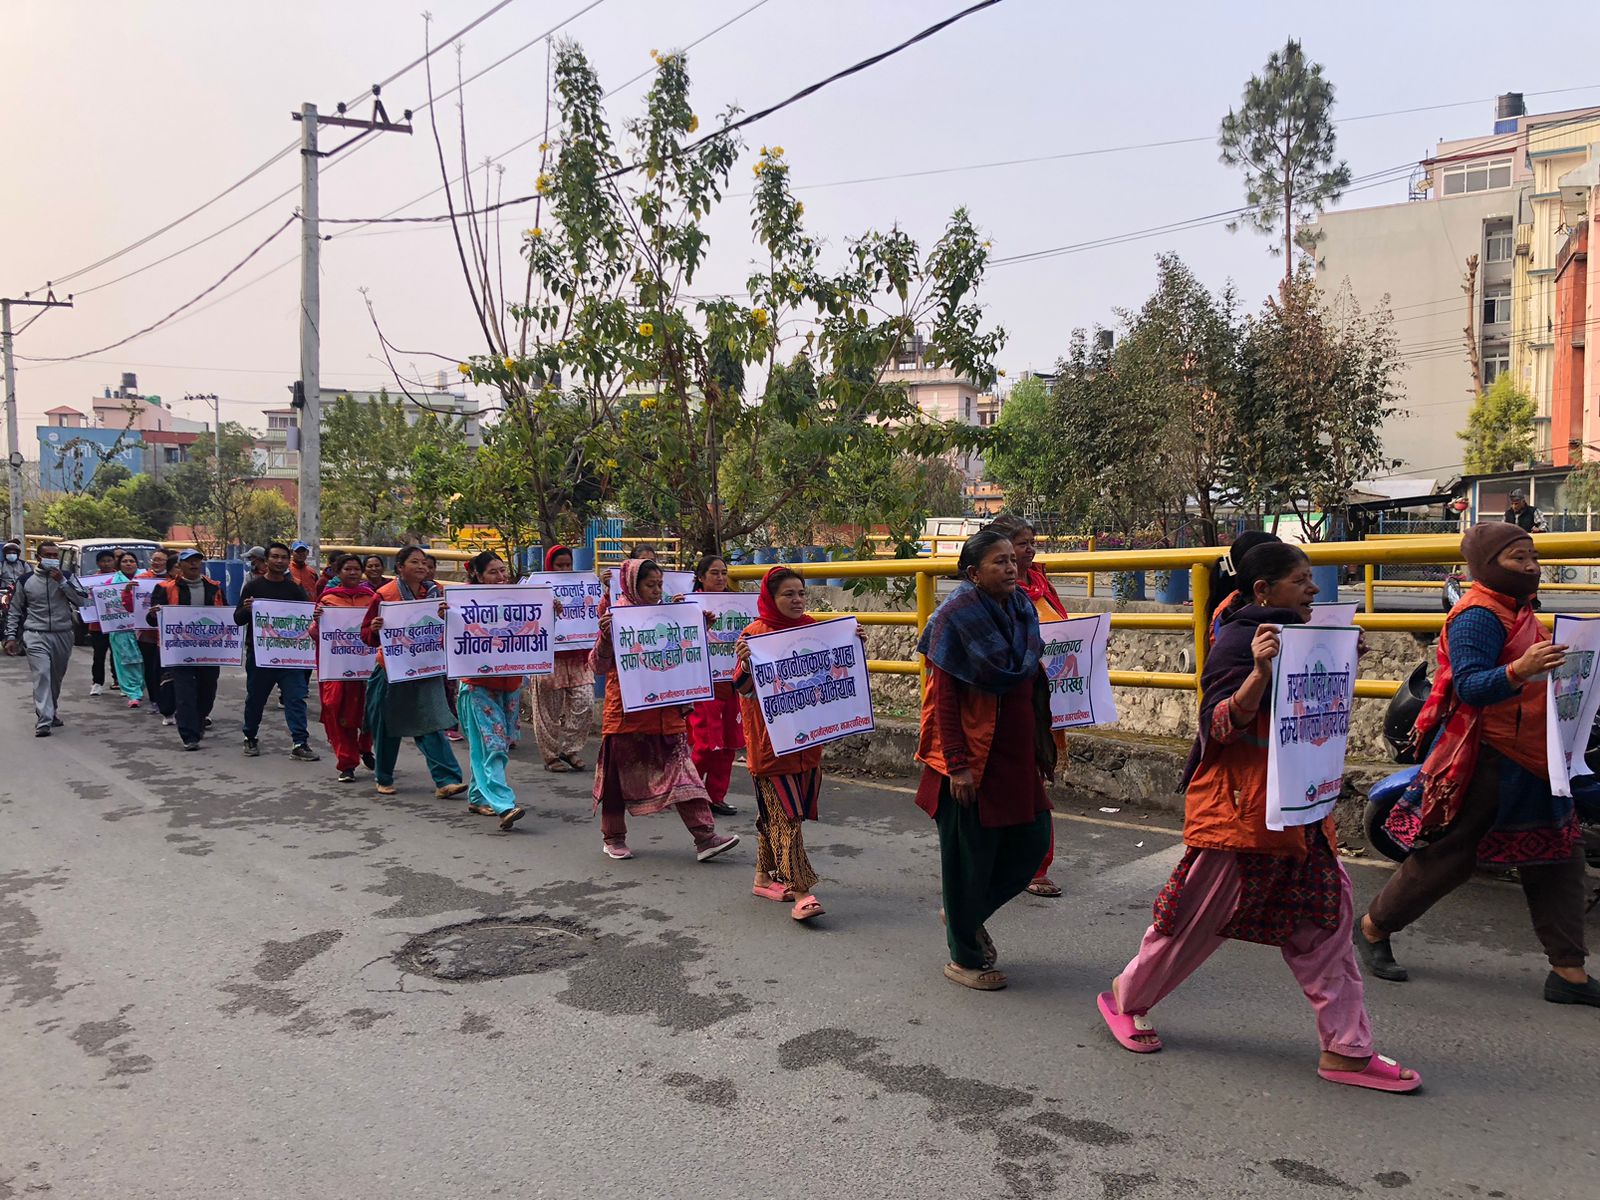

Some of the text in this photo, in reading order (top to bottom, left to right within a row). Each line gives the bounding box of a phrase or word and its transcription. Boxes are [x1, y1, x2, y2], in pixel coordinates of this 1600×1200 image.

[461, 599, 543, 624] खोला बचाऊ
[322, 628, 362, 641] प्लास्टिकल
[384, 622, 444, 640] सफा बुढानील
[454, 631, 494, 655] जीवन
[620, 626, 635, 647] मेरो
[637, 629, 656, 646] नगर
[666, 622, 681, 643] मेरो
[683, 625, 698, 641] नाम
[331, 645, 365, 655] वातावरण
[409, 638, 443, 658] बुढानील
[620, 653, 640, 672] सफा
[685, 646, 701, 663] काम
[755, 644, 856, 688] सफा बुढानीलकण्ठ आहा
[818, 675, 857, 704] अभियान
